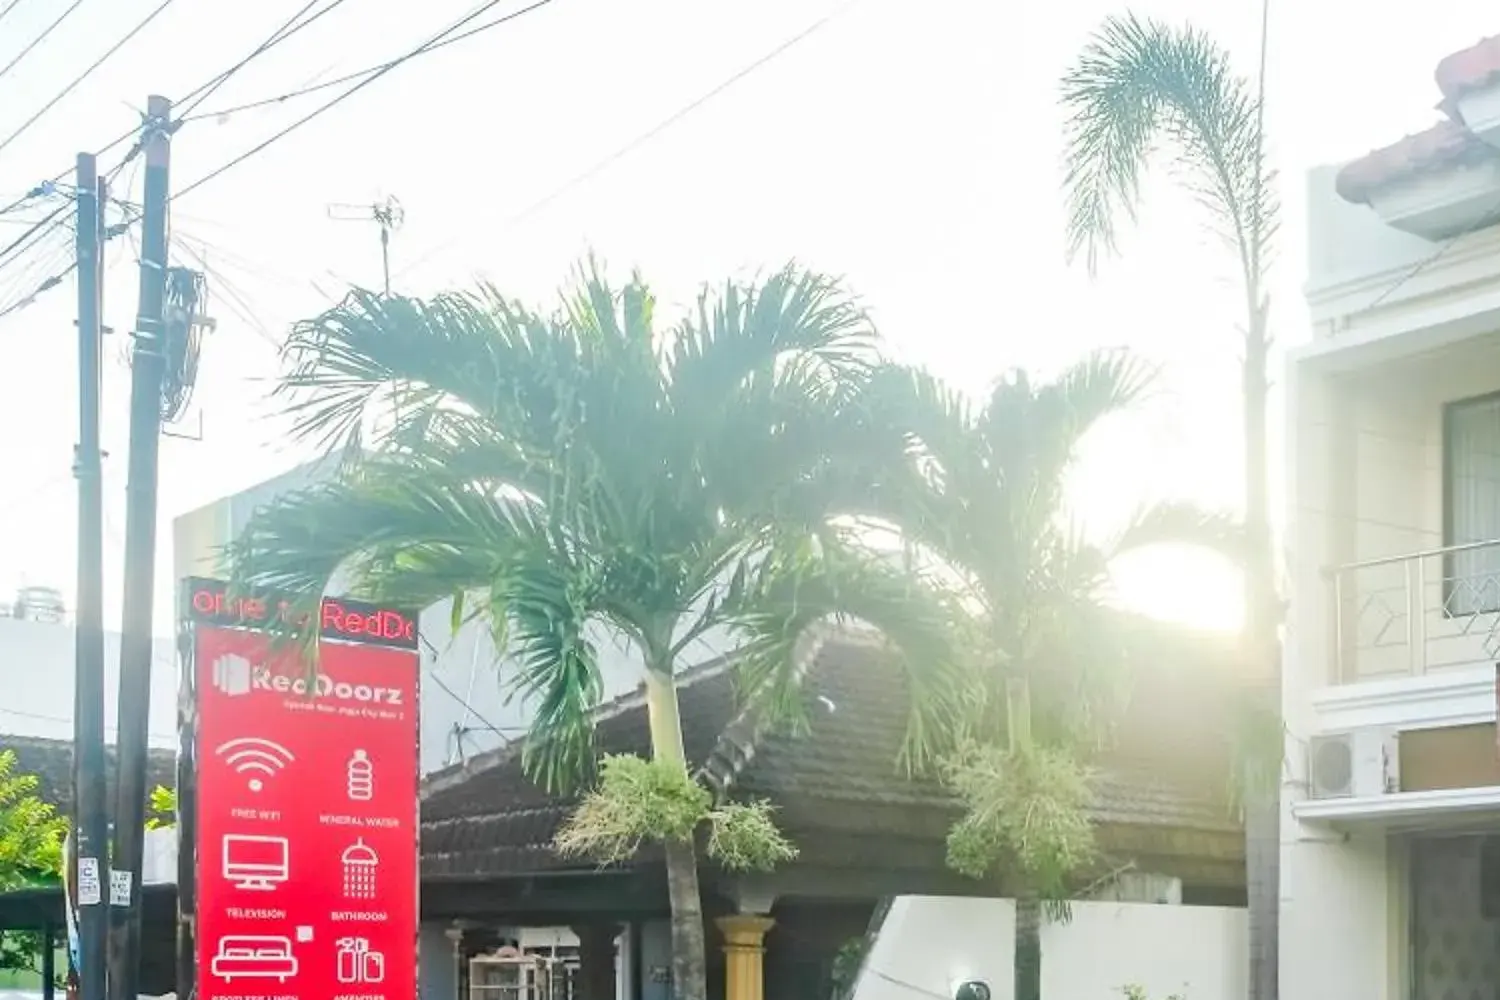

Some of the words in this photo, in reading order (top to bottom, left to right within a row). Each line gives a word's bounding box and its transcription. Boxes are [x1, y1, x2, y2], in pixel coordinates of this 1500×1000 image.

[319, 814, 364, 826] MINERAL
[366, 817, 399, 828] WATER
[225, 907, 286, 919] TELEVISION
[330, 911, 388, 921] BATHROOM
